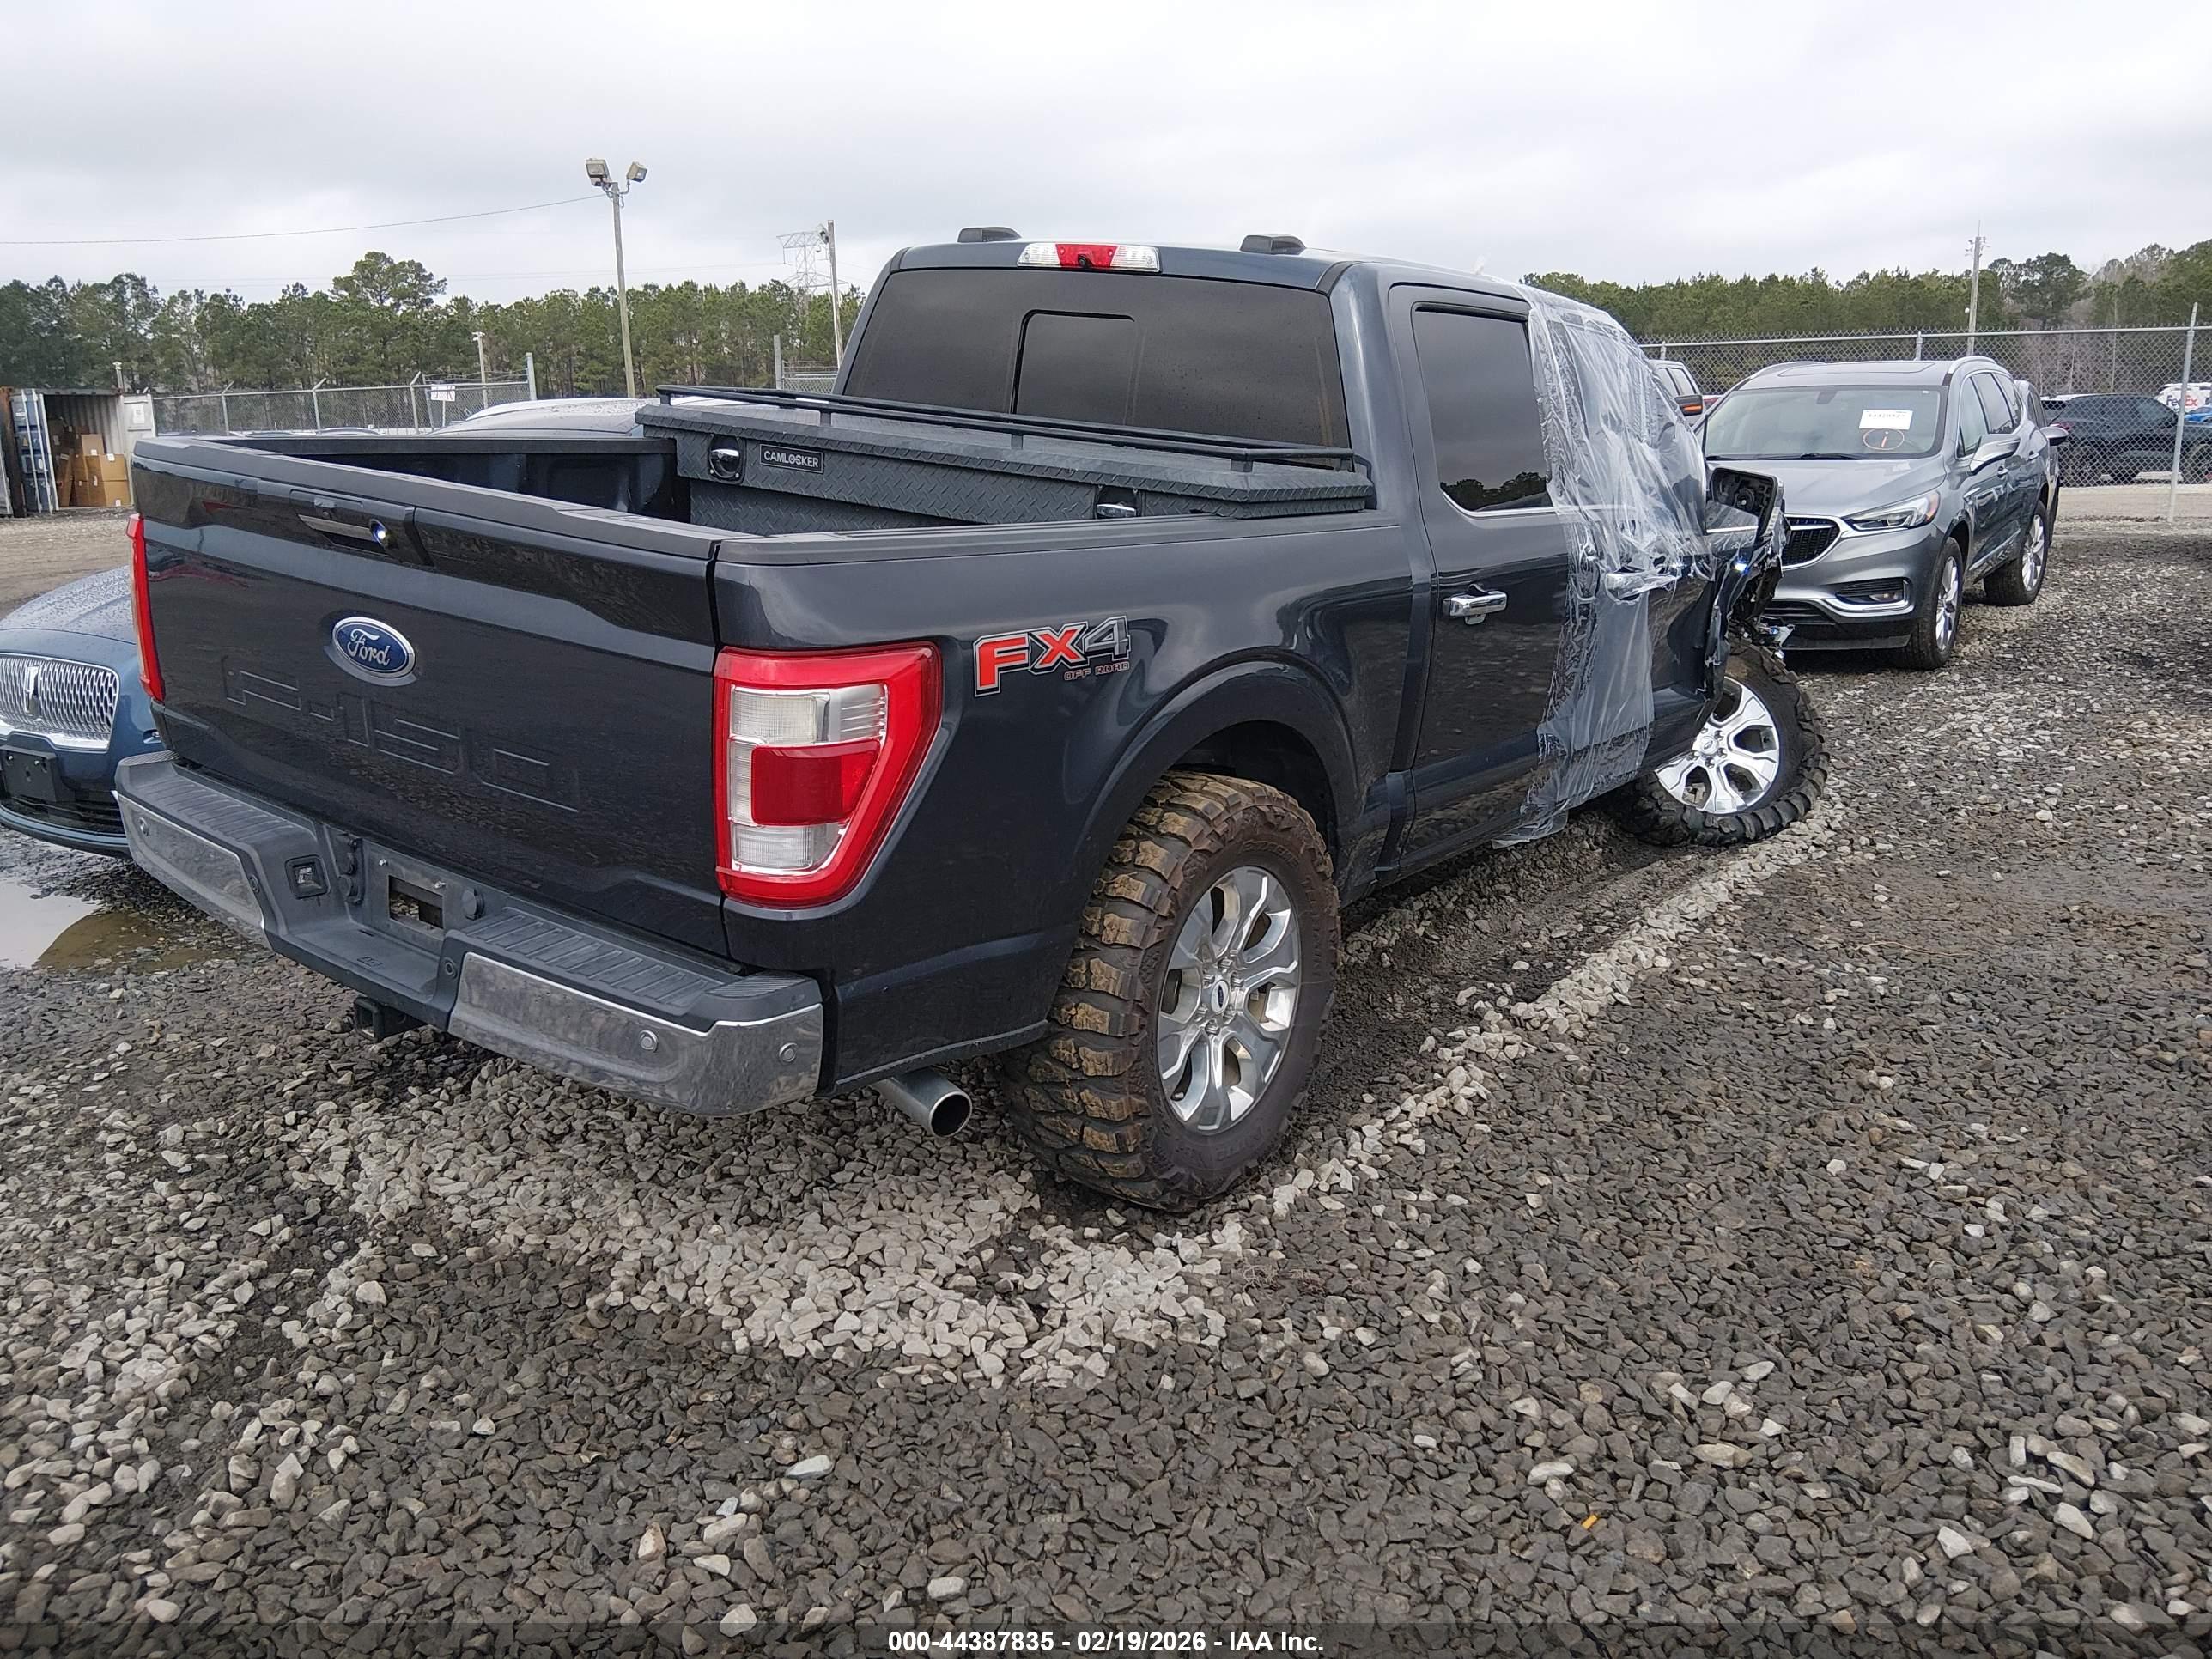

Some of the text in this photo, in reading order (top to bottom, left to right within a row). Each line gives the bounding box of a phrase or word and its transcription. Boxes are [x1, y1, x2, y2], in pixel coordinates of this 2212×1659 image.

[763, 450, 820, 468] CAMLOCKER
[347, 628, 392, 667] Ford
[974, 616, 1131, 696] FX4
[1063, 661, 1130, 681] OFF ROAD
[222, 654, 581, 813] F-150
